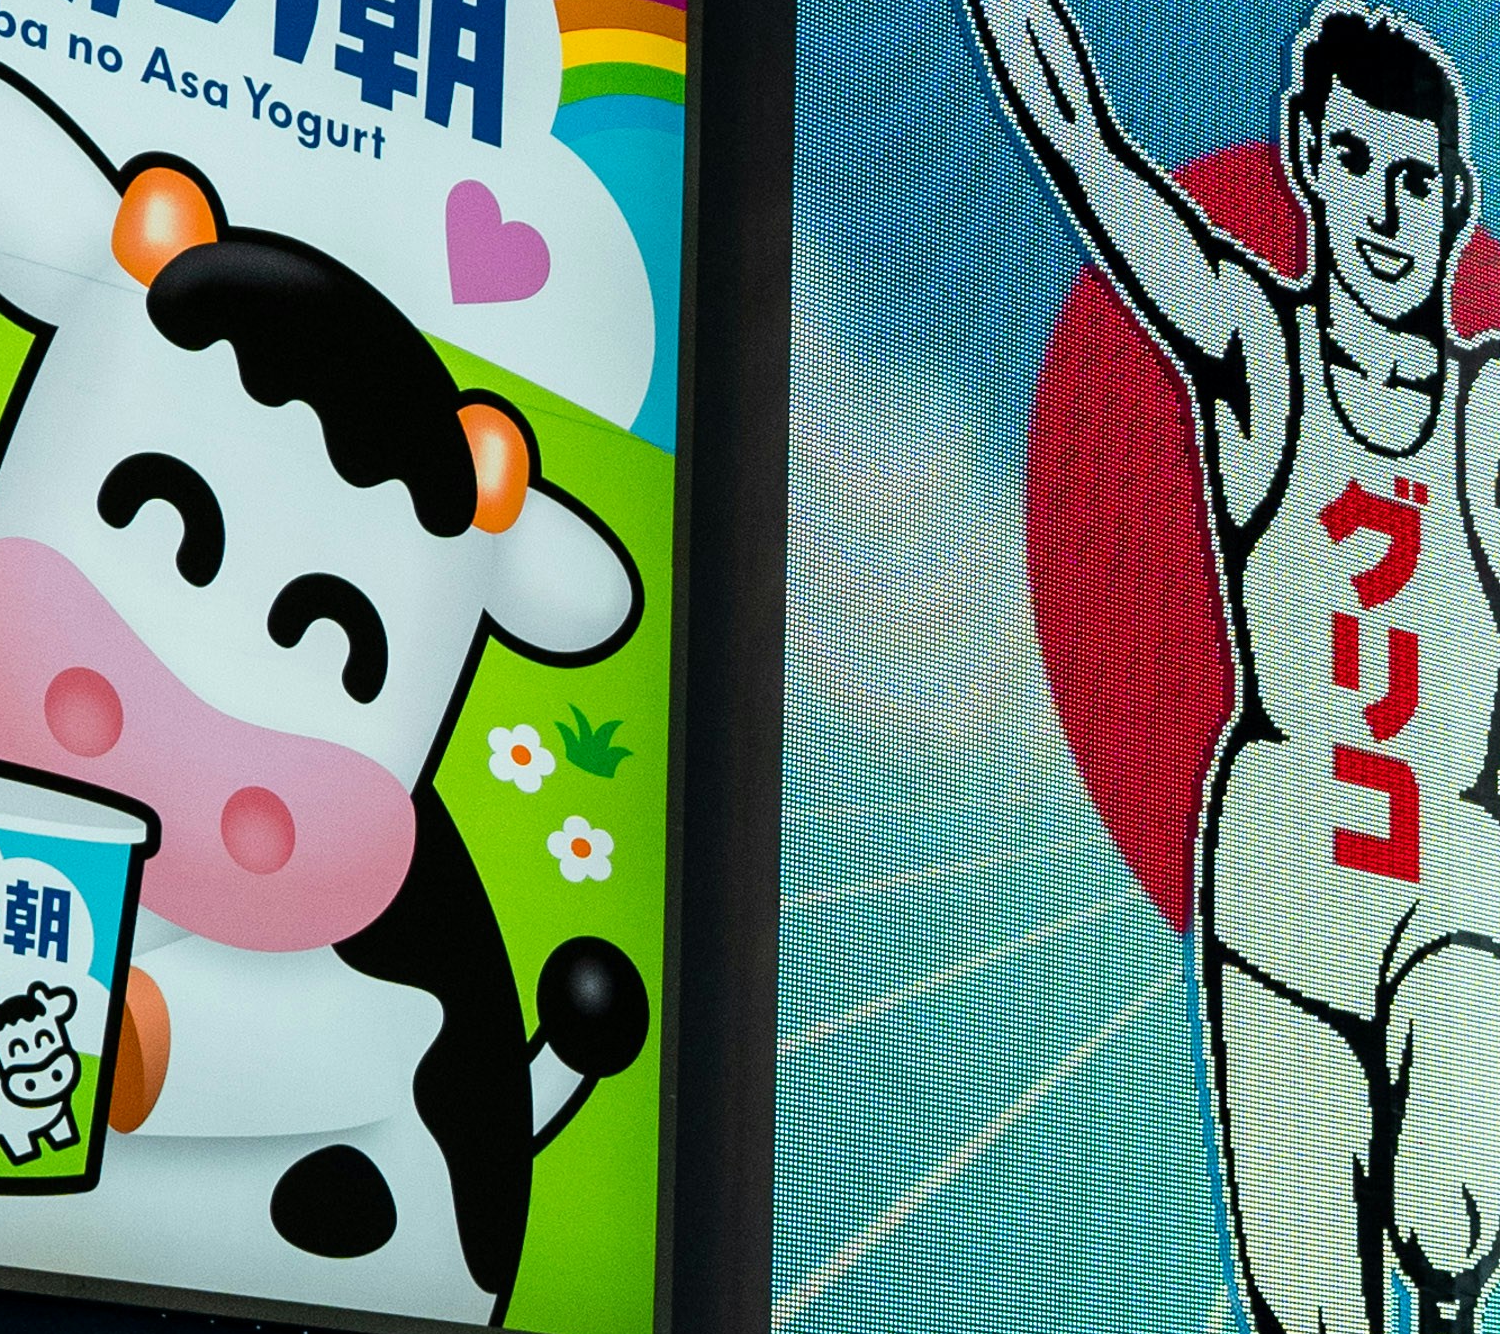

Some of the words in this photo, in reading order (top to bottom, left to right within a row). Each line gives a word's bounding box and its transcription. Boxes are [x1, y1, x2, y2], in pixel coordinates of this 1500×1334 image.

[69, 33, 124, 75] no
[140, 47, 230, 110] Asa
[243, 76, 388, 160] Yogurt
[1317, 476, 1428, 885] グリコ
